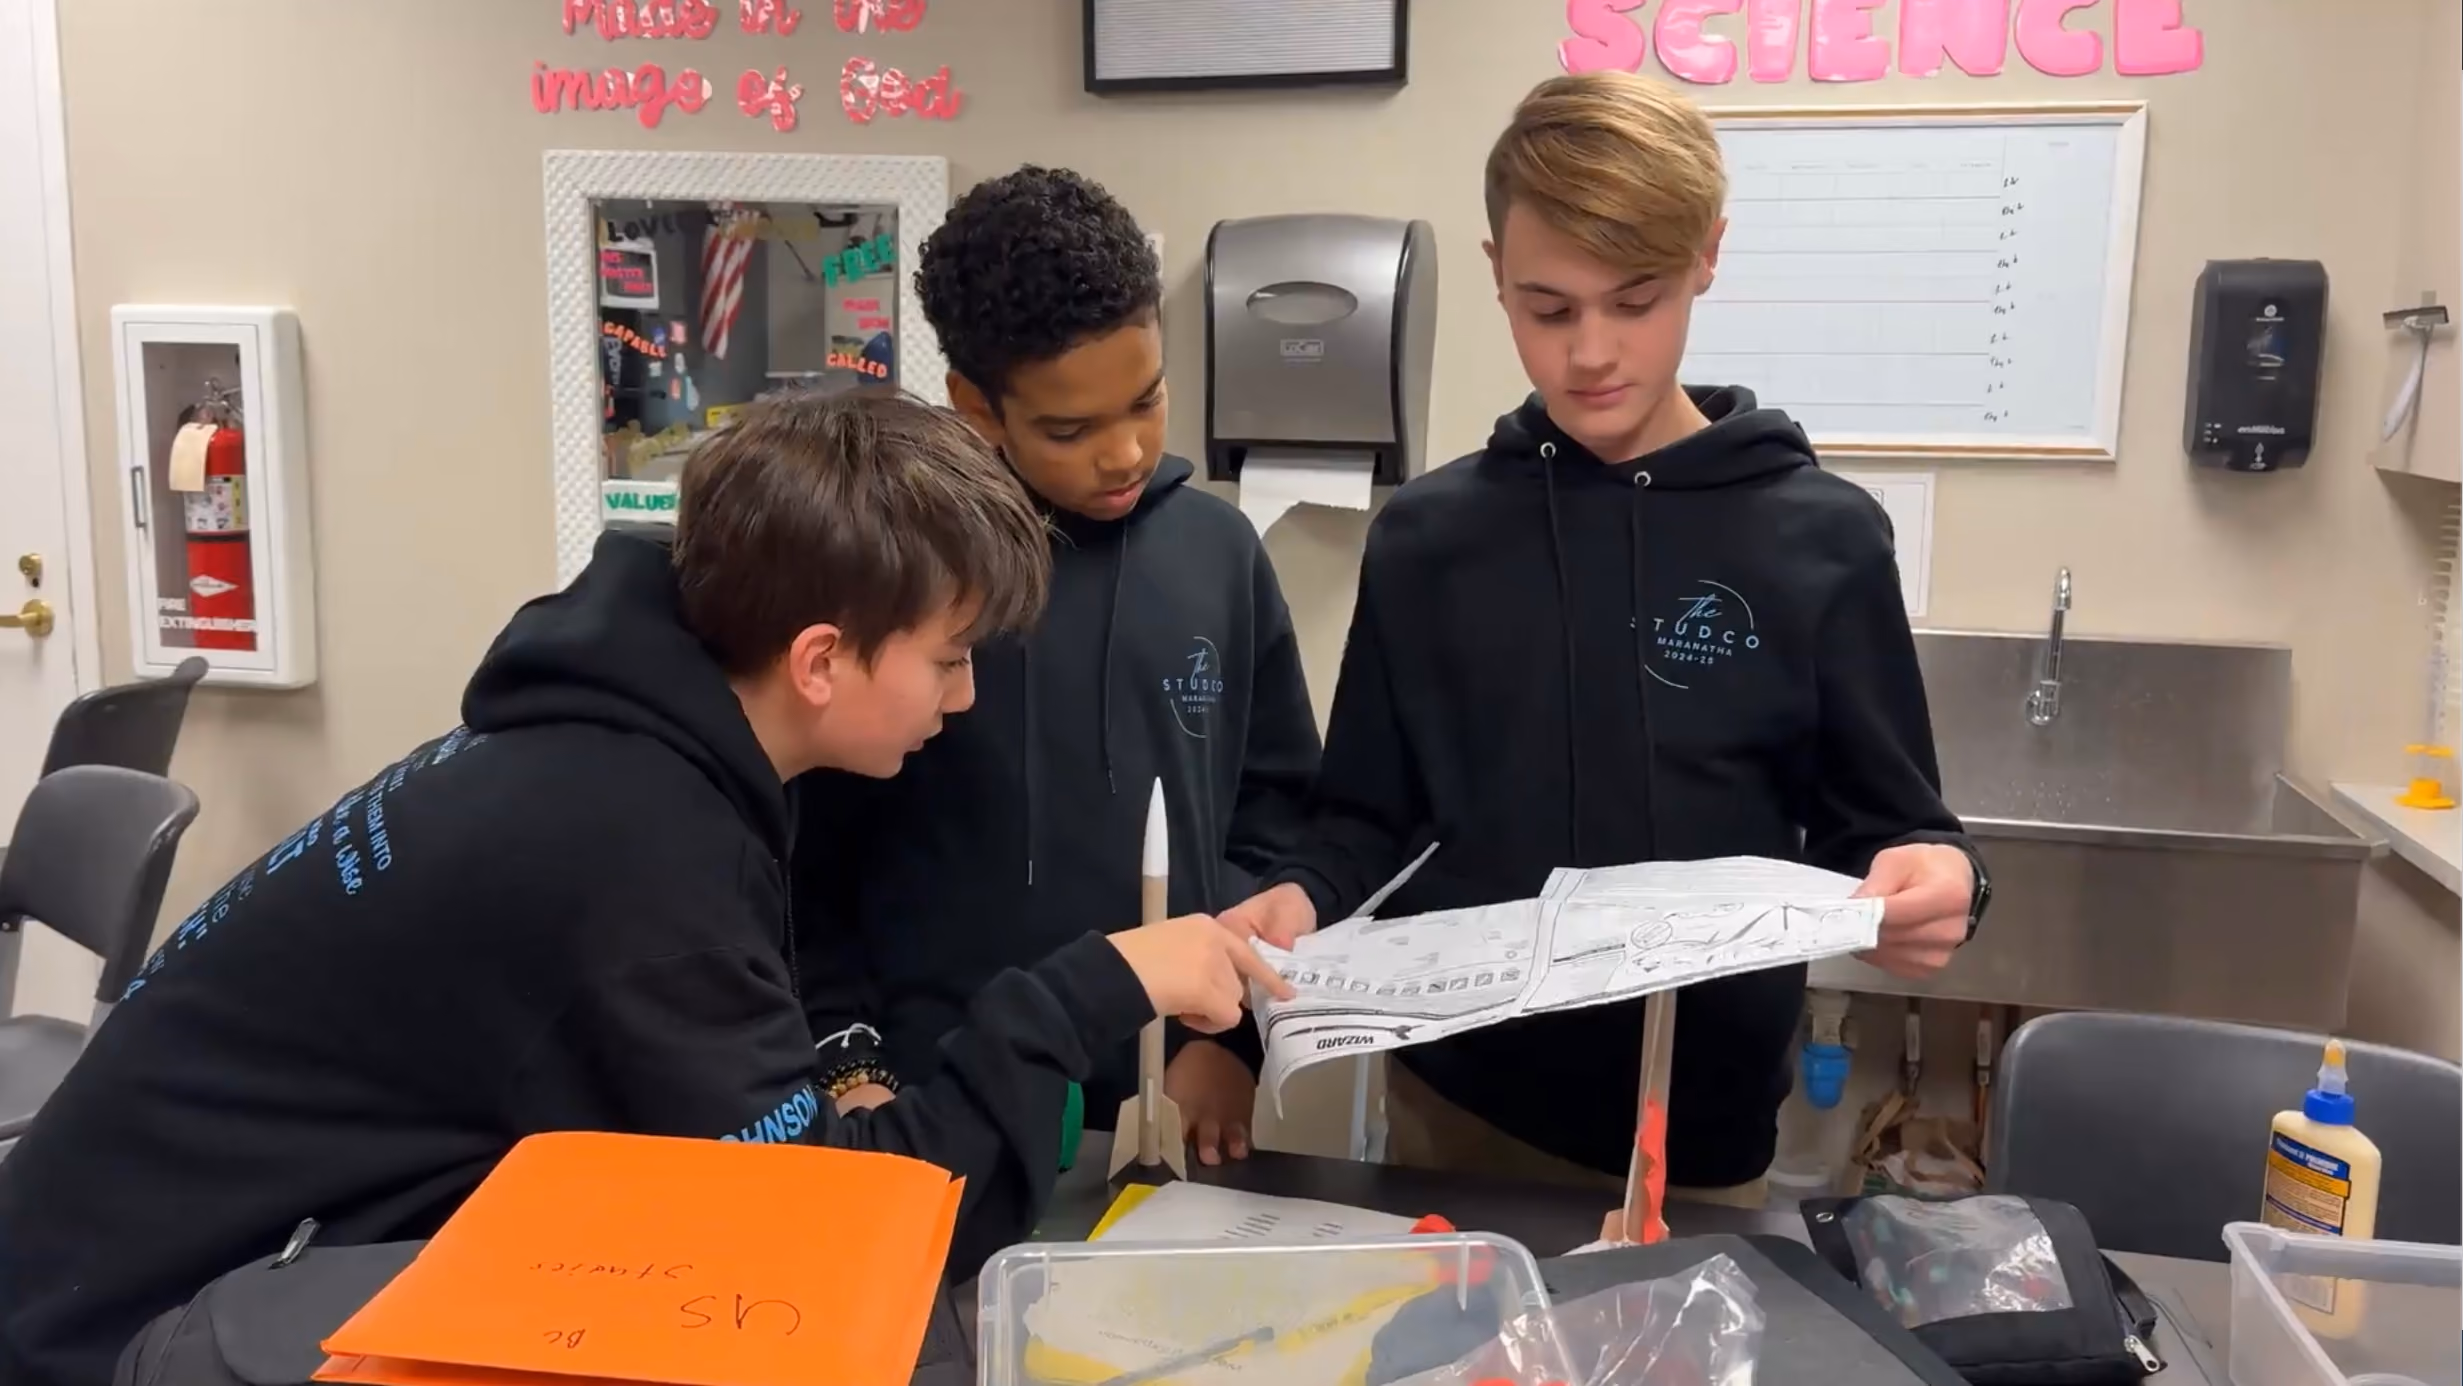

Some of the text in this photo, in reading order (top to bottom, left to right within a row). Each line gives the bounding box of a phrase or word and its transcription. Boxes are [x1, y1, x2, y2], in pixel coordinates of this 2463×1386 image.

[1558, 0, 2205, 84] SCIENCE
[530, 55, 962, 133] image of God
[821, 232, 895, 289] FREE
[826, 353, 888, 379] CALLED
[1656, 637, 1733, 657] MARANATHA
[370, 829, 392, 870] INTO
[1316, 1035, 1375, 1050] WIZARD
